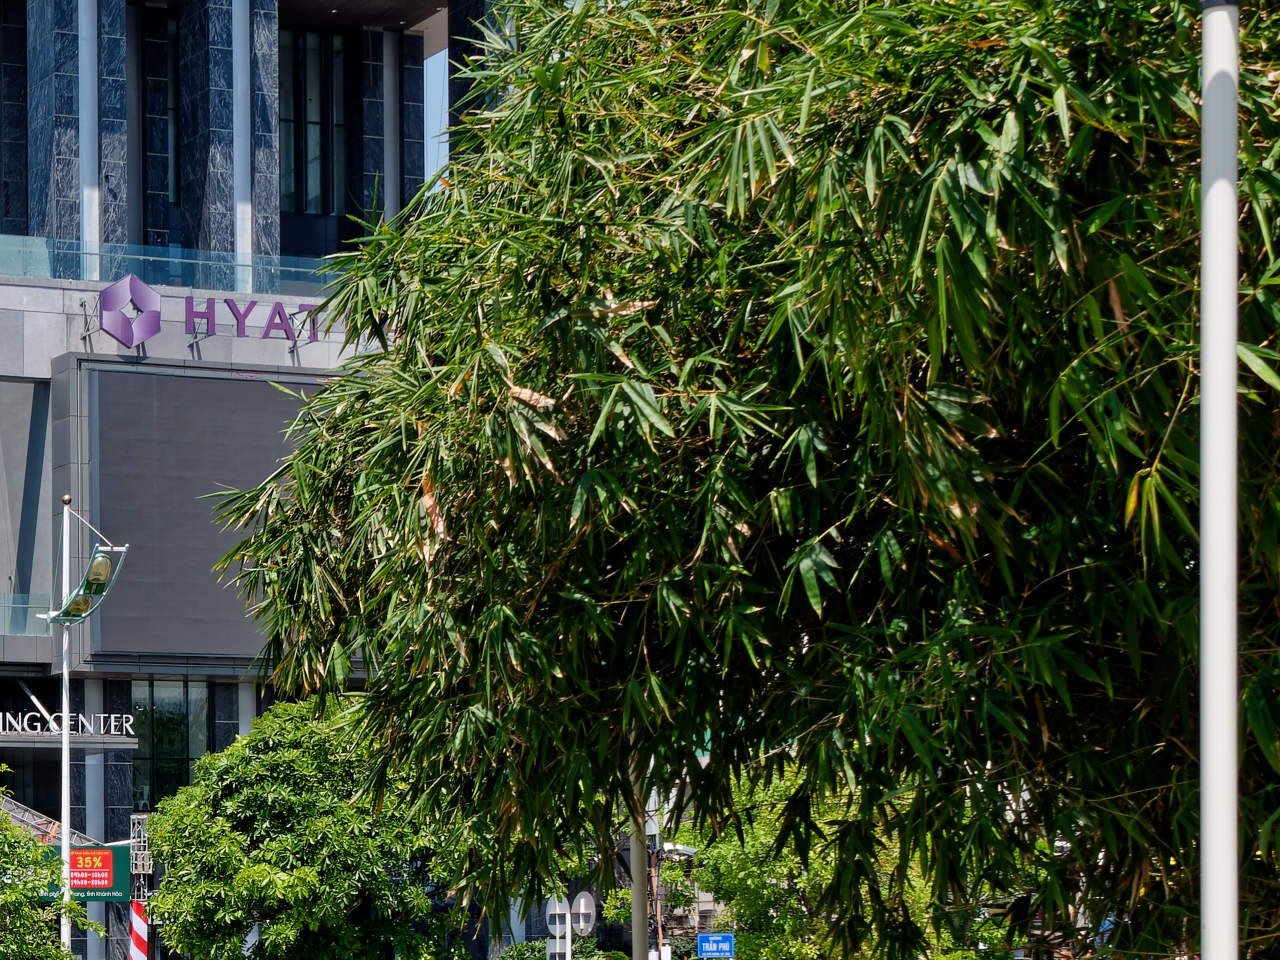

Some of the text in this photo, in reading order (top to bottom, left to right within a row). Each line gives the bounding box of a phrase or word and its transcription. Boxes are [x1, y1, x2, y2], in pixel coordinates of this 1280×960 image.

[185, 295, 354, 343] HYAT
[48, 712, 135, 736] CENTER
[76, 855, 102, 868] 35%
